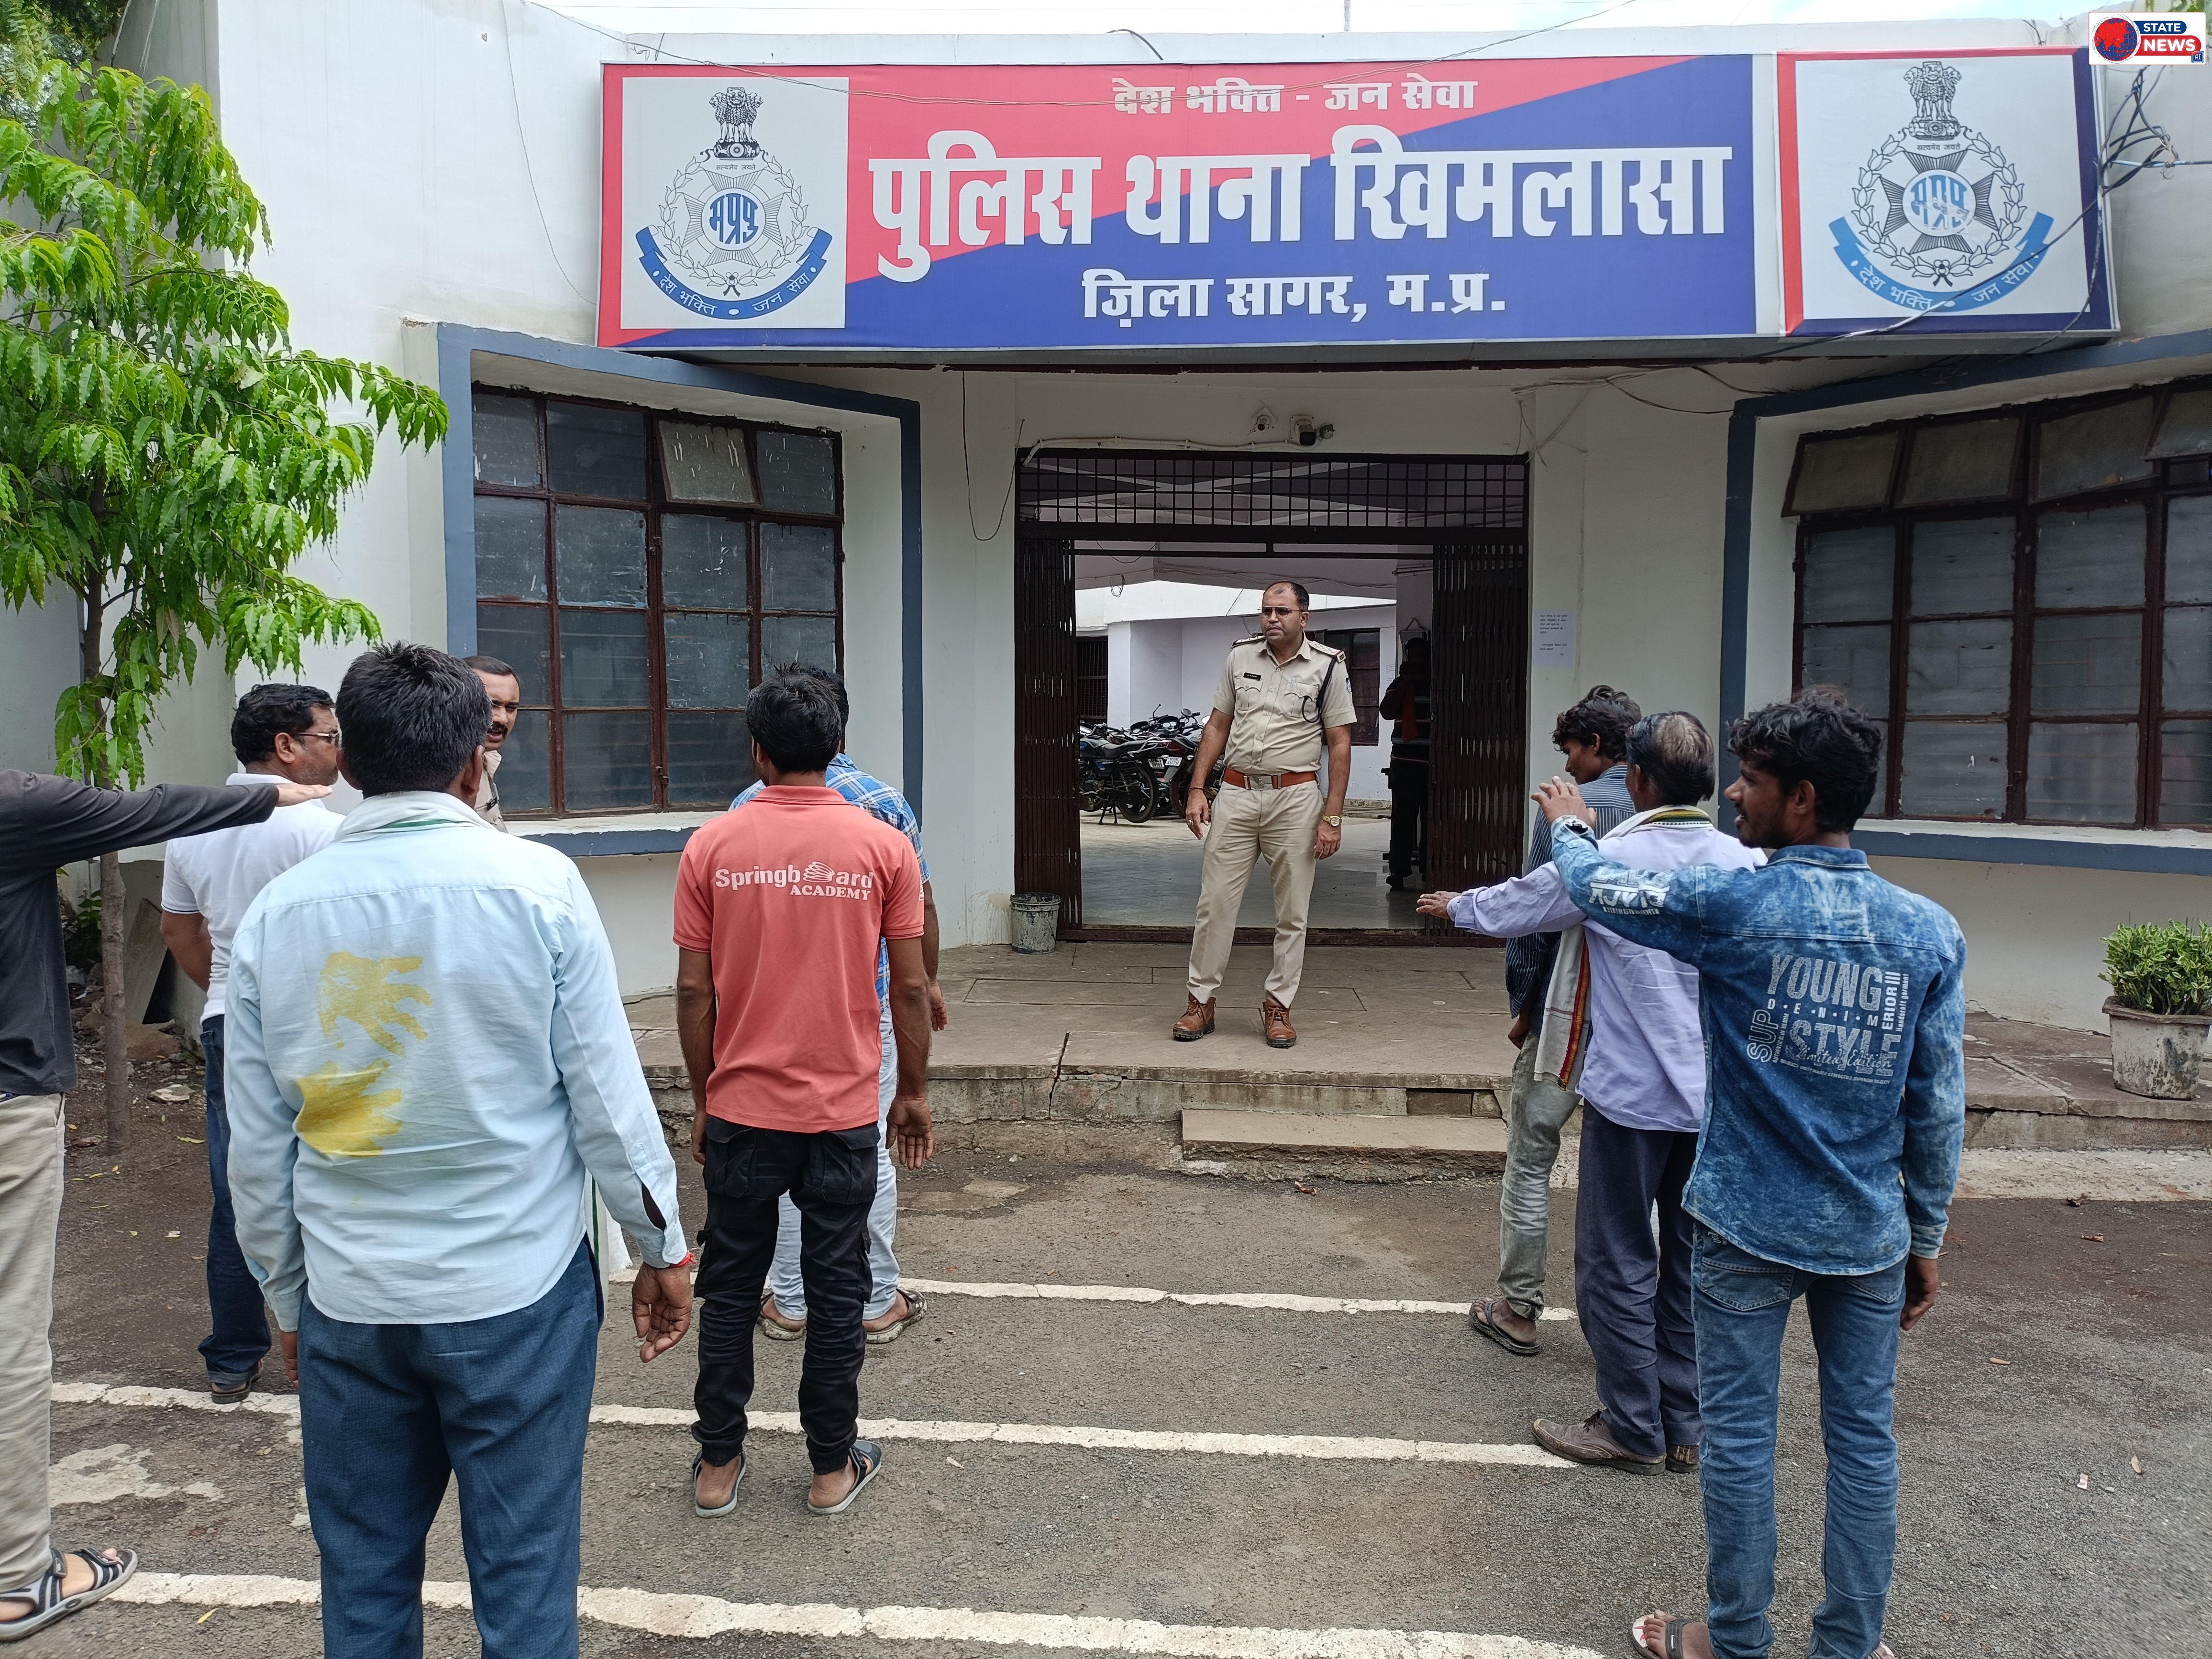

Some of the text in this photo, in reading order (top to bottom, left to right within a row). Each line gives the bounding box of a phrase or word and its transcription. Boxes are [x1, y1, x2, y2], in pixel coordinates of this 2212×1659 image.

[1323, 82, 1392, 111] जन
[1401, 73, 1478, 109] सेवा
[868, 124, 1733, 282] पुलिस थाना खिमलासा
[659, 272, 811, 316] देश भक्ति जन सेवा
[1225, 276, 1368, 323] सागर,
[1859, 261, 2035, 311] देश भक्ति जन सेवा
[716, 861, 874, 891] Springbard
[789, 885, 871, 901] ACADEMY
[1767, 954, 1883, 1011] YOUNG
[1747, 1009, 1779, 1062] SUP
[1881, 986, 1897, 1030] ERIOR
[1785, 1019, 1901, 1076] STYLE
